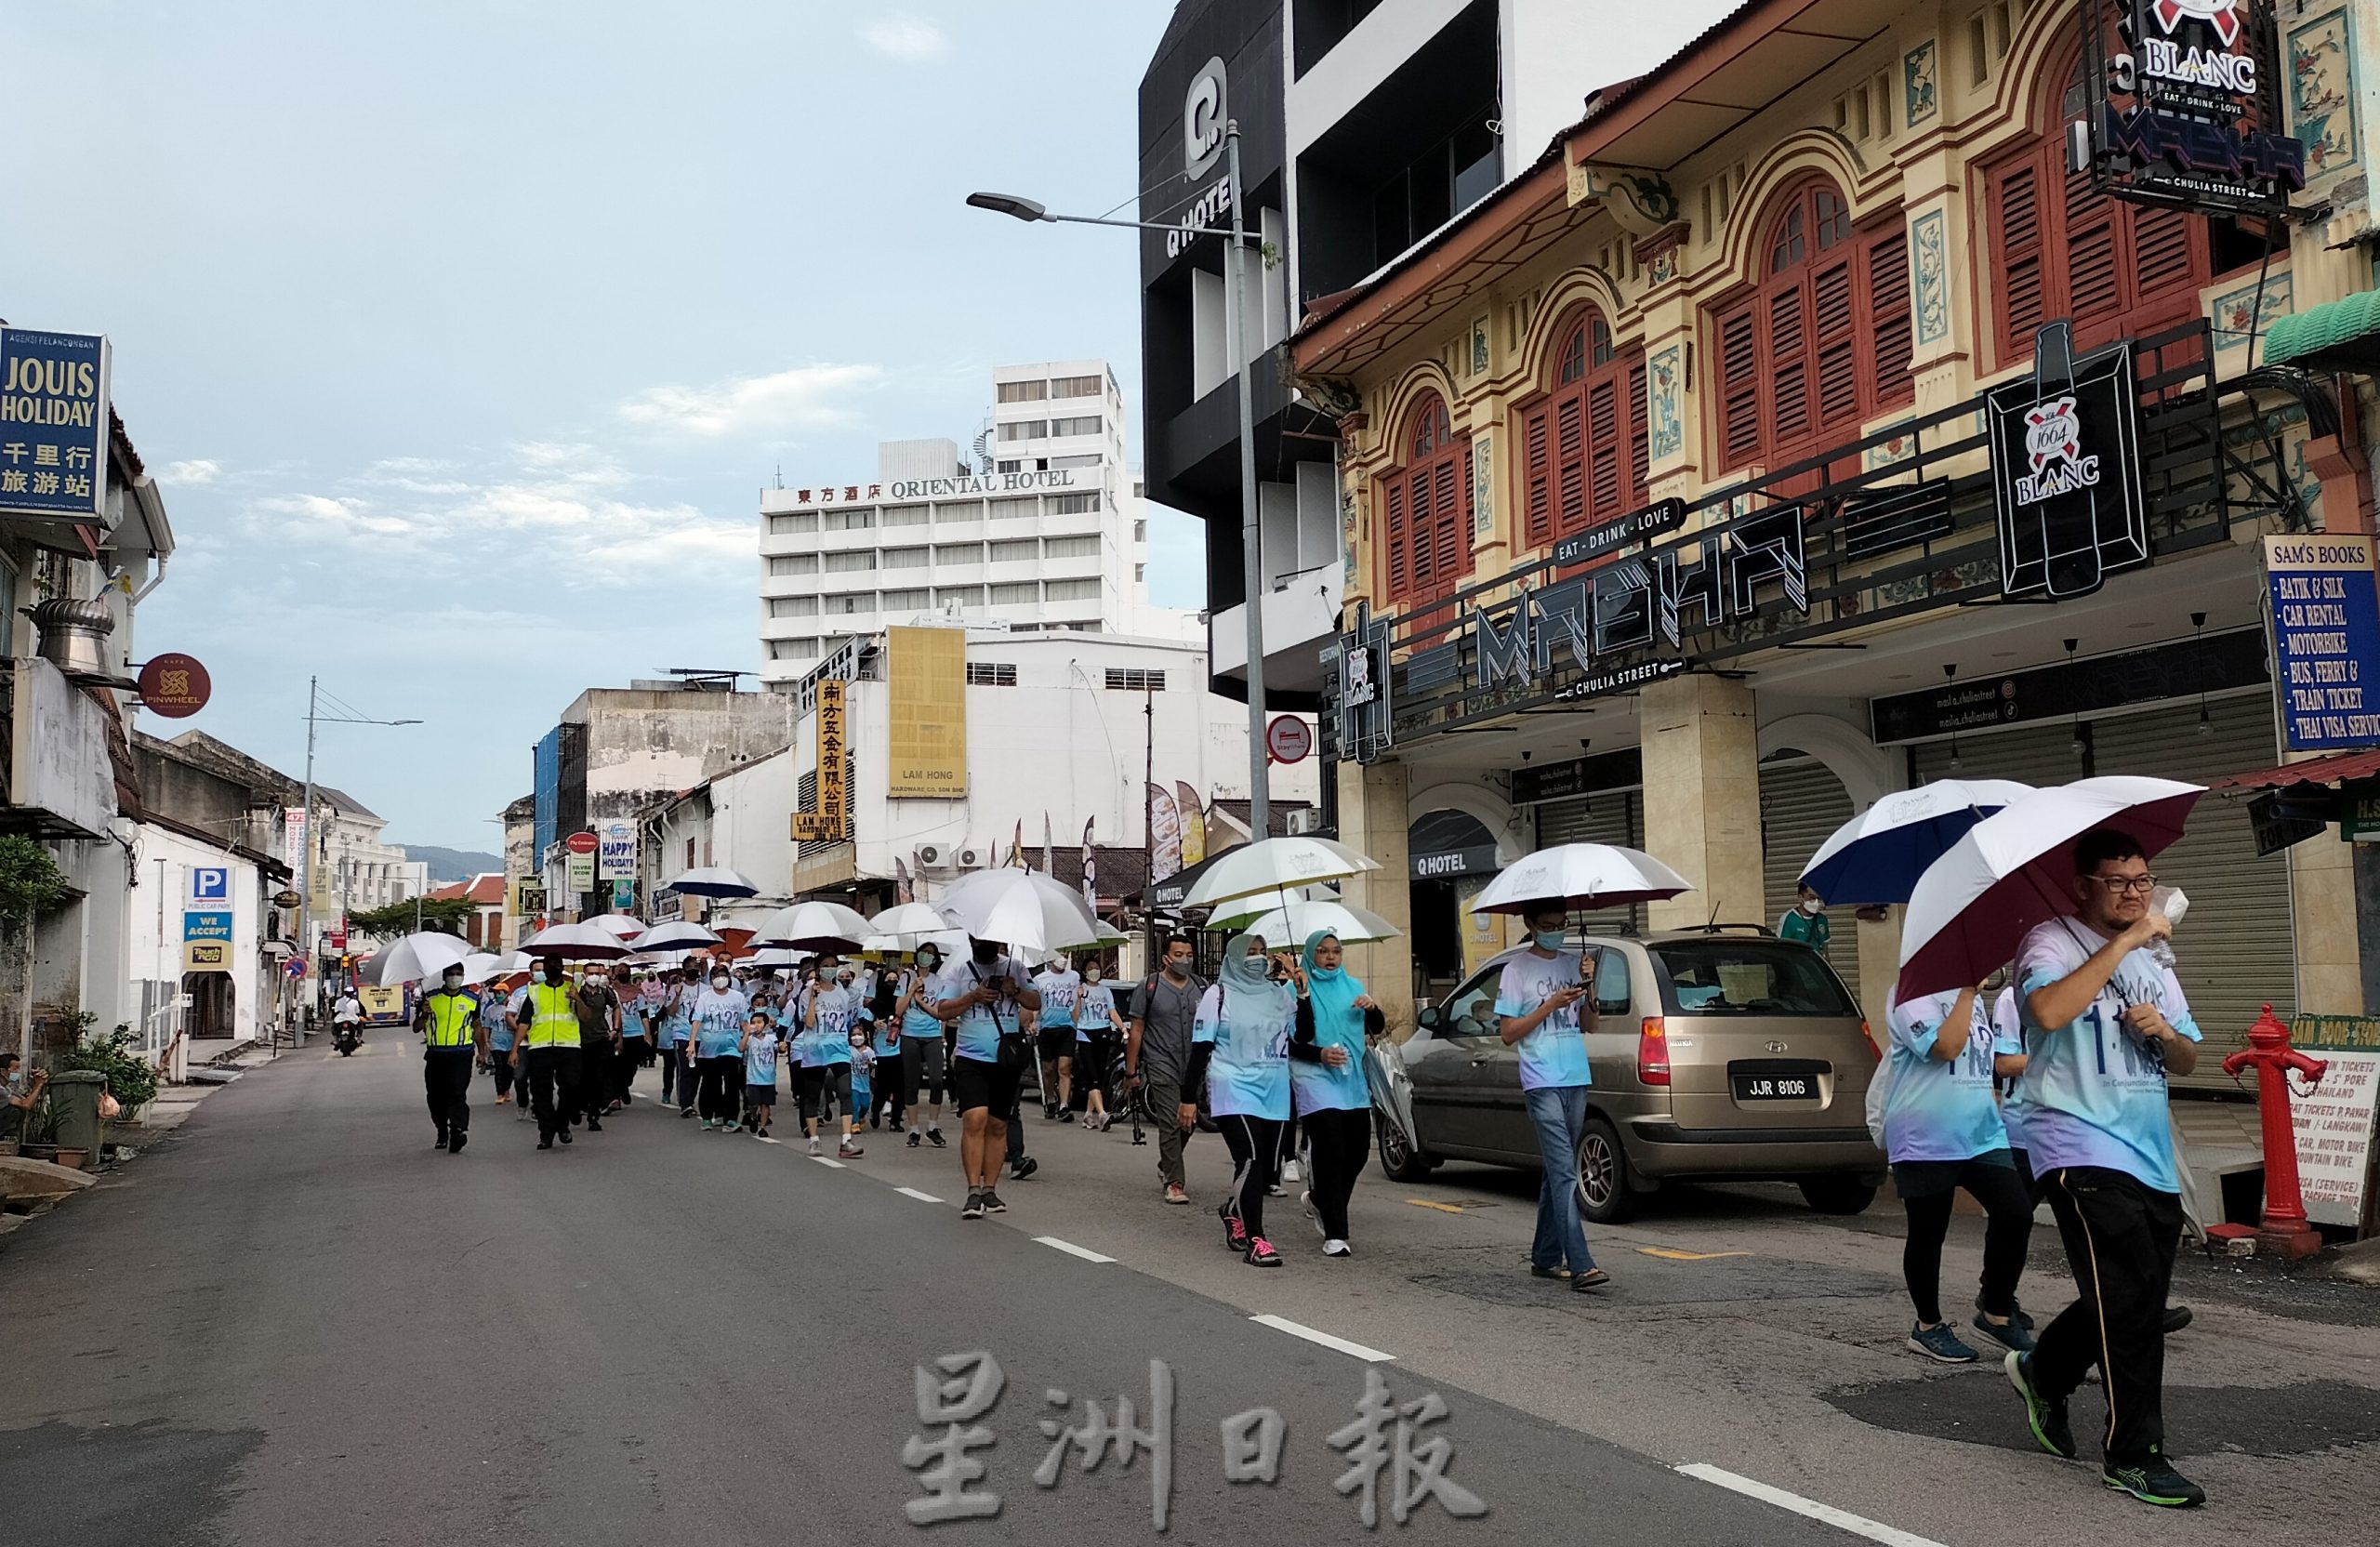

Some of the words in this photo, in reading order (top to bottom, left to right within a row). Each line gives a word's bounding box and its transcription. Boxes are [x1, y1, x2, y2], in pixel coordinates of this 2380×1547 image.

[2146, 39, 2255, 93] BLANC
[2164, 93, 2179, 103] EAT
[2188, 97, 2213, 109] DRINK
[2221, 104, 2241, 114] LOVE
[2174, 178, 2210, 192] CHULIA
[2213, 184, 2246, 197] STREET
[1167, 230, 1180, 258] Q
[5, 356, 94, 398] JOUIS
[1, 395, 95, 428] HOLIDAY
[2037, 423, 2069, 449] 1664
[3, 443, 91, 469] 千里行
[1, 469, 91, 497] 旅游站
[892, 475, 998, 499] ORIENTAL
[1003, 469, 1075, 490] HOTEL
[2016, 456, 2099, 506] BLANC
[798, 484, 880, 505] 東方酒店
[1559, 545, 1580, 561] EAT
[1590, 523, 1626, 550] DRINK
[1637, 507, 1670, 532] LOVE
[2274, 543, 2314, 563] SAM'S
[2319, 546, 2365, 563] BOOKS
[2279, 577, 2310, 599] BATIK
[2312, 577, 2320, 599] &
[2322, 577, 2346, 599] SILK
[2282, 605, 2305, 627] CAR
[2306, 604, 2347, 626] RENTAL
[2287, 632, 2347, 654] MOTORBIKE
[1576, 675, 1616, 695] CHULIA
[1618, 662, 1659, 684] STREET
[2290, 661, 2314, 687] BUS,
[2315, 661, 2347, 682] FERRY
[1346, 683, 1374, 707] BLANC
[2293, 689, 2325, 711] TRAIN
[2327, 688, 2362, 709] TICKET
[2295, 717, 2322, 739] THAI
[2322, 716, 2347, 737] VISA
[822, 682, 842, 817] 南方五金有限公司
[903, 770, 923, 780] LAM
[927, 770, 953, 780] HONG
[797, 816, 814, 826] LAM
[819, 816, 841, 826] HONG
[602, 842, 634, 855] HAPPY
[602, 858, 634, 867] HOLIDAYS
[1418, 858, 1427, 876] Q
[1428, 853, 1466, 874] HOTEL
[199, 870, 221, 895] P
[1156, 888, 1162, 903] Q
[1162, 886, 1183, 901] HOTEL
[1475, 933, 1498, 943] HOTEL
[2291, 1021, 2314, 1044] SAM
[2319, 1022, 2348, 1045] BOOK
[2342, 1061, 2376, 1073] TICKETS
[1750, 1080, 1774, 1095] JJR
[1778, 1079, 1805, 1095] 8106
[2345, 1074, 2367, 1086] PORE
[2305, 1104, 2335, 1117] TICKETS
[2345, 1106, 2370, 1119] PAYAR
[2322, 1120, 2367, 1133] LANGKAWI
[2318, 1138, 2345, 1152] MOTOR
[2347, 1141, 2366, 1154] BIKE
[2316, 1179, 2359, 1193] (SERVICE)
[2304, 1191, 2336, 1203] PACKAGE
[2339, 1195, 2360, 1208] TOUR
